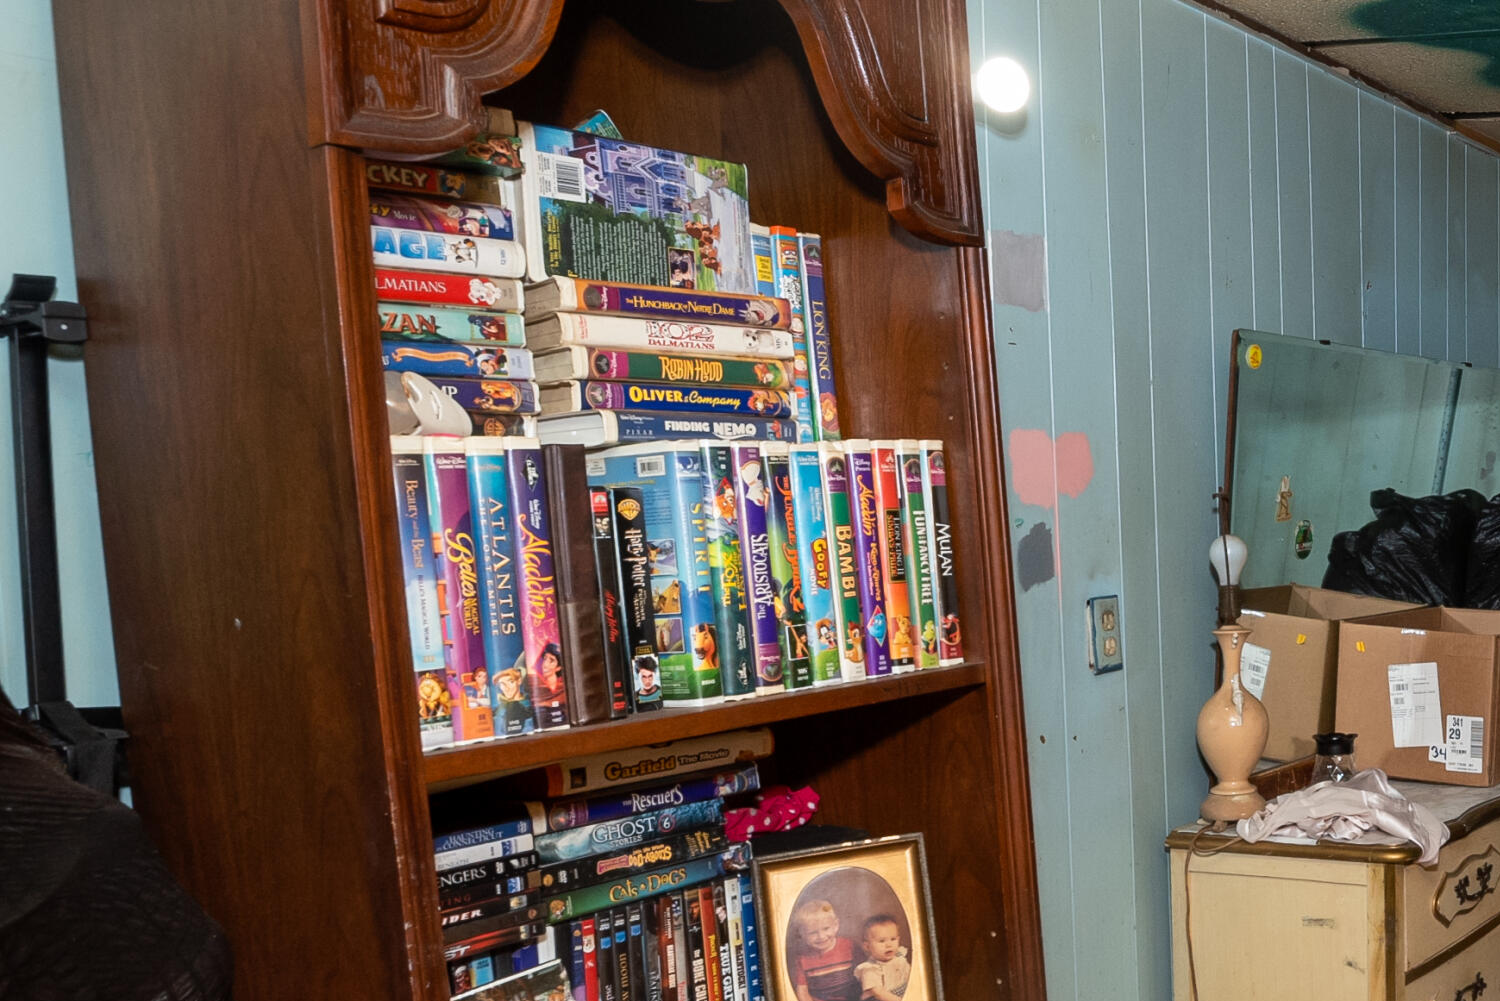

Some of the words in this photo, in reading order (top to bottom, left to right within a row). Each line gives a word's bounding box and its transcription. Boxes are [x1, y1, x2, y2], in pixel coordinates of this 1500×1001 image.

[393, 210, 417, 222] Movie
[374, 228, 447, 262] AGE
[633, 296, 684, 312] HUNCHBACK
[688, 300, 713, 316] NOTRE
[713, 303, 735, 316] DAME
[811, 300, 826, 335] LION
[381, 312, 437, 334] ZAN
[648, 339, 715, 350] DALMATIANS
[815, 338, 832, 381] KING
[658, 356, 695, 382] ROBIN
[694, 359, 724, 383] HOOD
[629, 386, 684, 403] OLIVER
[688, 391, 741, 410] Company
[664, 421, 711, 434] FINDING
[712, 422, 757, 439] NEMO
[405, 480, 419, 520] Beauty
[856, 474, 875, 536] Aladdin
[893, 516, 901, 541] LION
[912, 509, 928, 534] FUN
[411, 539, 425, 569] Beast
[623, 527, 645, 557] Harry
[895, 542, 903, 568] KING
[917, 538, 931, 576] FANCY
[935, 523, 952, 576] MULAN
[487, 496, 517, 636] ATLANTIS
[517, 513, 558, 622] Aladdin
[623, 556, 648, 588] Potter
[751, 533, 774, 606] ARISTOCATS
[814, 538, 829, 589] GOOFY
[834, 525, 857, 599] BAMBI
[920, 576, 933, 605] FREE
[463, 598, 473, 630] WORLD
[470, 598, 480, 635] MAGICAL
[1449, 728, 1461, 740] 29
[604, 756, 675, 782] Garfield
[593, 816, 657, 843] GHOST
[663, 816, 671, 829] 6
[610, 834, 643, 848] STORIES
[618, 953, 629, 987] moon
[692, 958, 706, 981] BONE
[719, 943, 730, 975] TRUE
[746, 925, 759, 987] ALIEN
